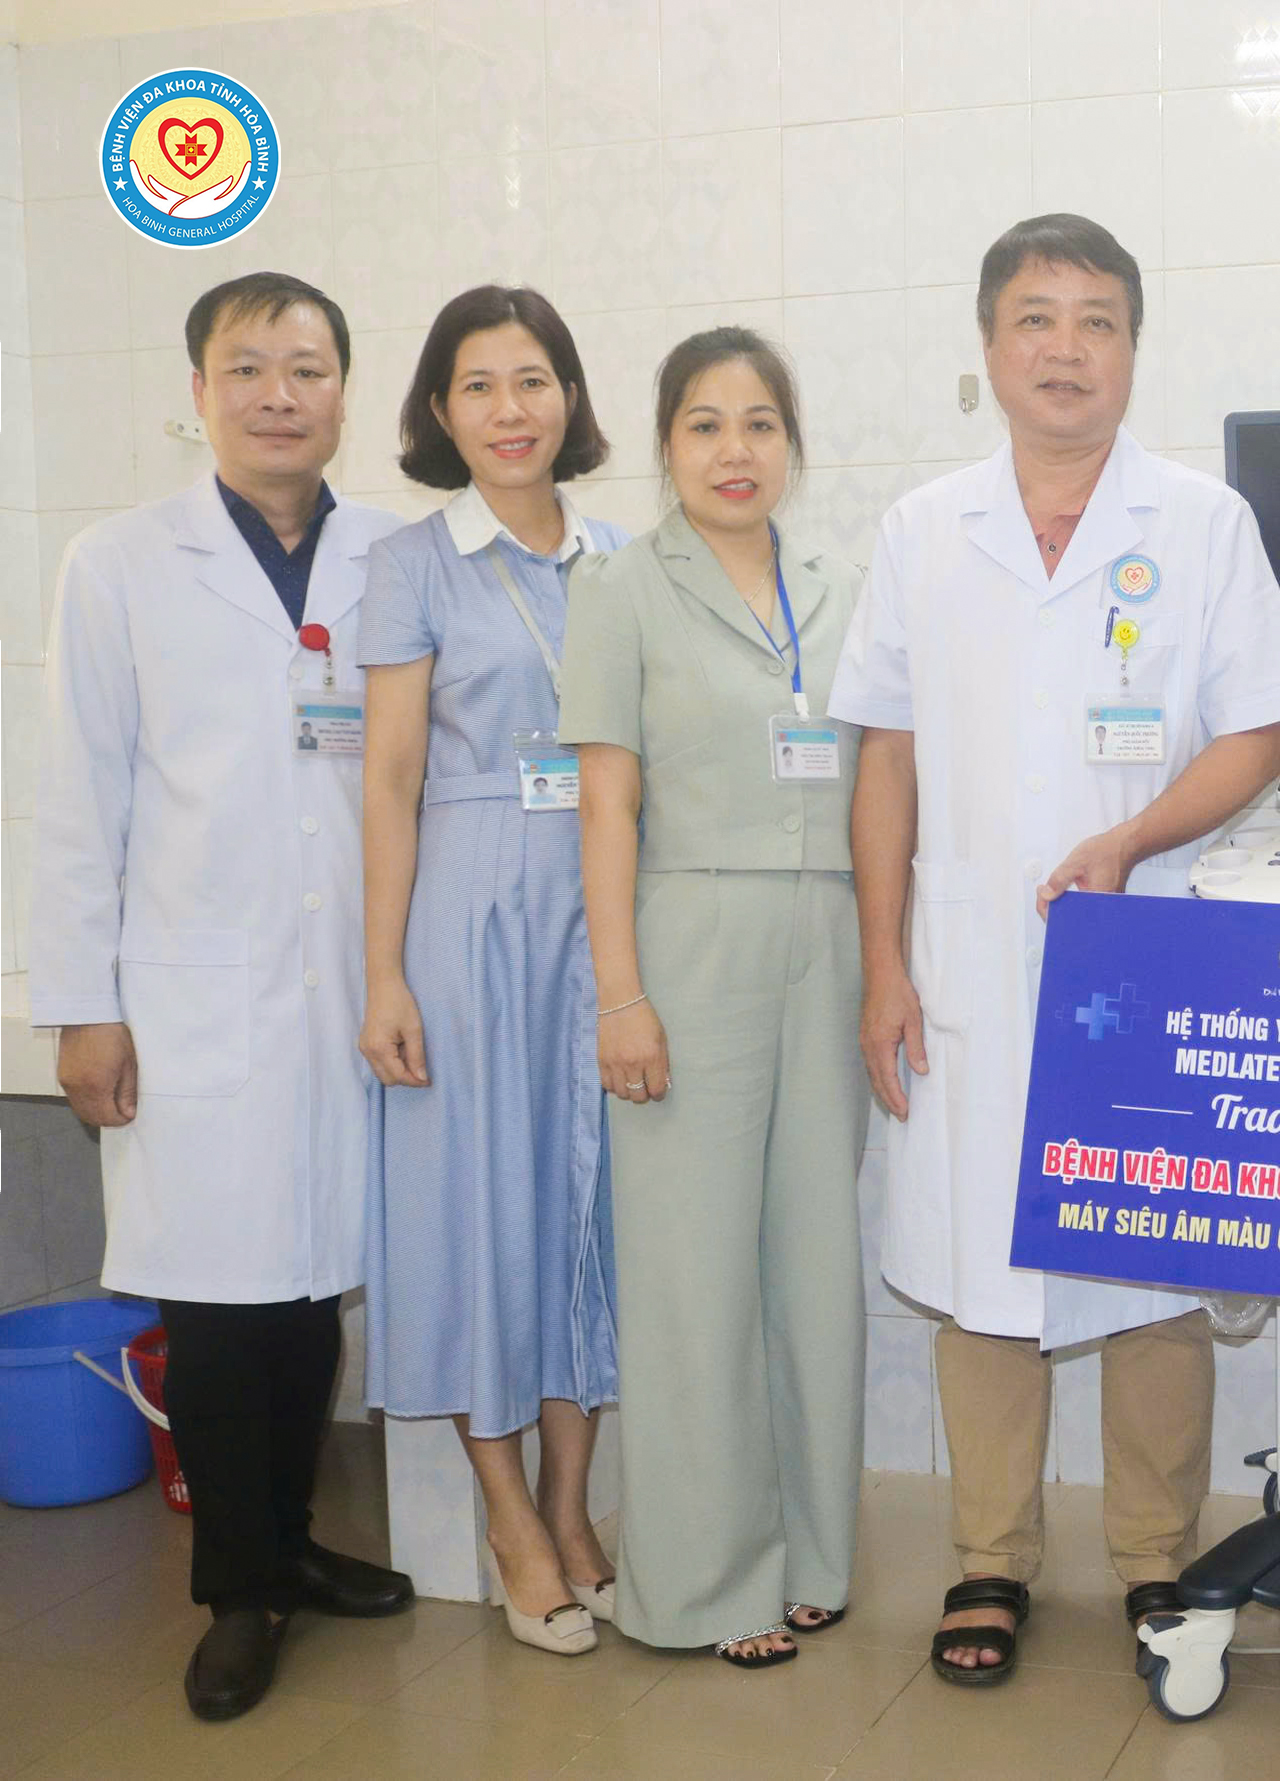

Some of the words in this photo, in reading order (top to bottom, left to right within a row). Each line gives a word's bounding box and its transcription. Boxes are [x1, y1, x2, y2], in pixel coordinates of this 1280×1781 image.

[1166, 1007, 1193, 1041] HỆ
[1200, 1007, 1268, 1042] THỐNG
[1042, 1138, 1118, 1185] BỆNH
[1123, 1147, 1188, 1194] VIỆN
[1191, 1157, 1231, 1195] ĐA
[1058, 1200, 1109, 1232] MÁY
[1114, 1206, 1167, 1240] SIÊU
[1172, 1209, 1211, 1244] ÂM
[1217, 1216, 1271, 1250] MÀU
